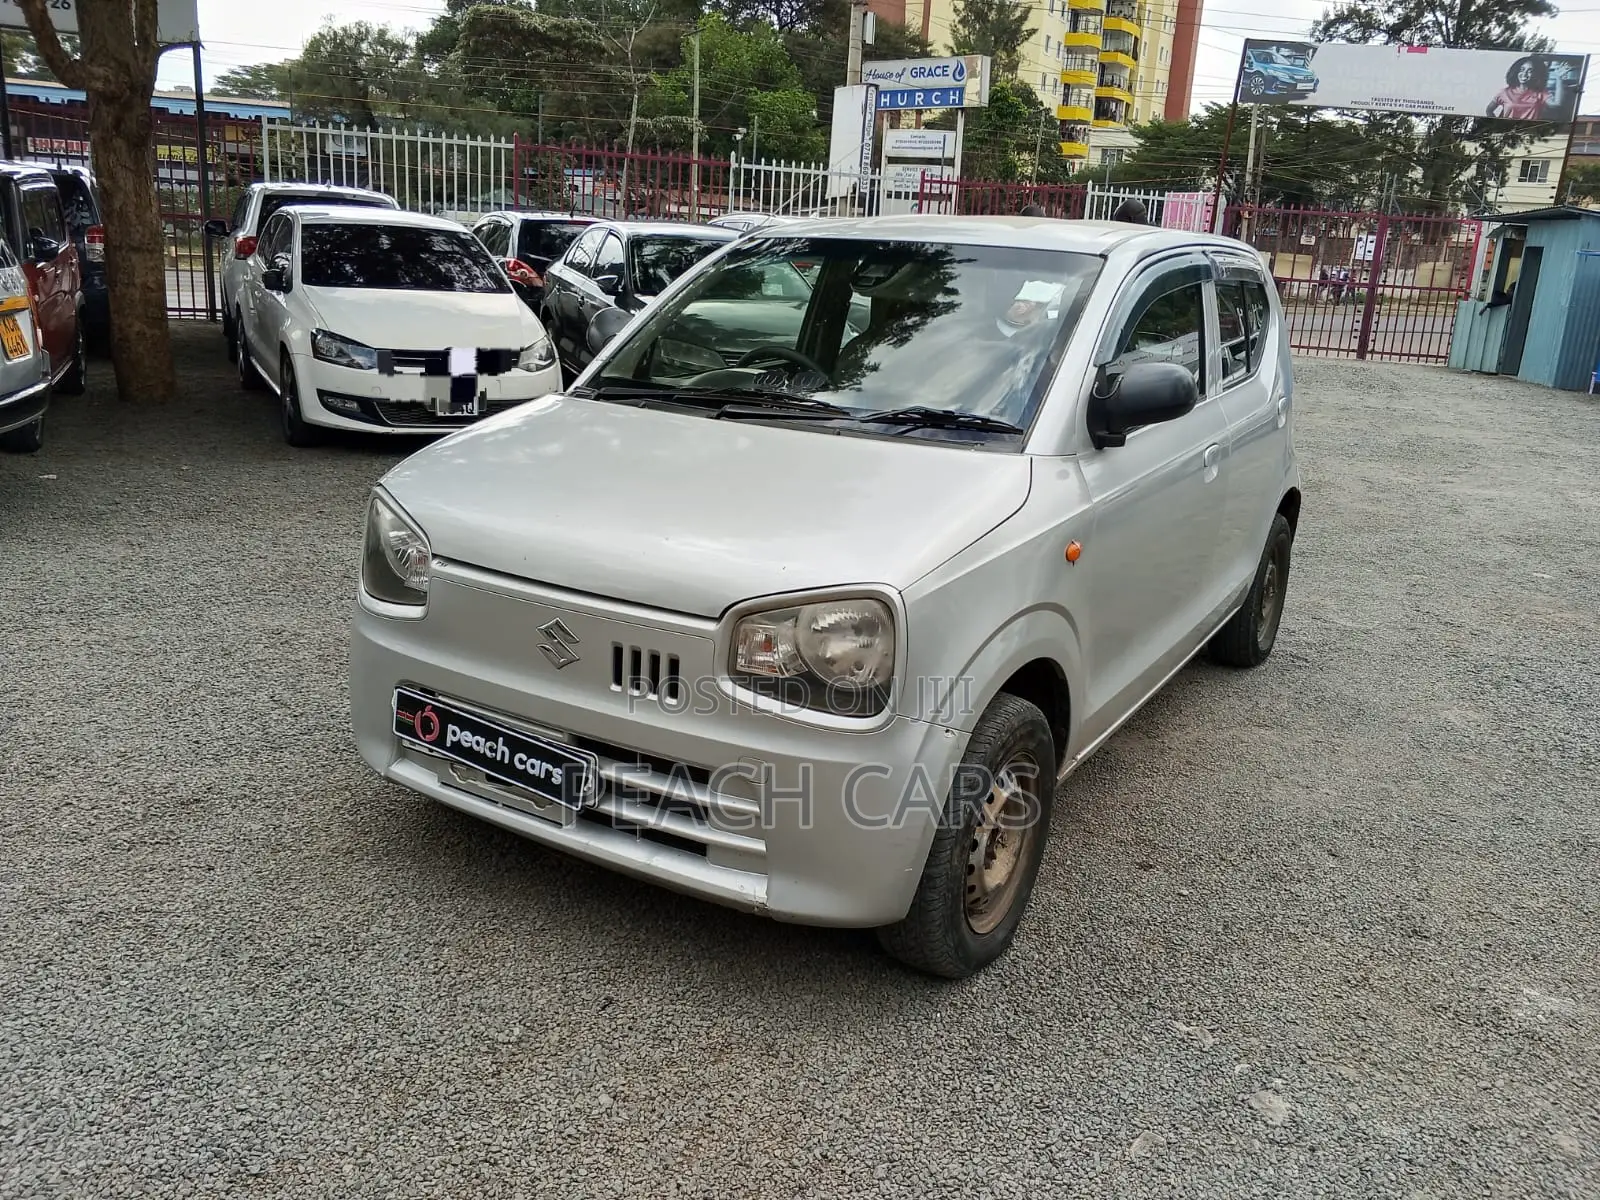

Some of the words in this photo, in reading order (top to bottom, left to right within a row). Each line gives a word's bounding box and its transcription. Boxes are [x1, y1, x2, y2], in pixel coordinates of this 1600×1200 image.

[864, 68, 894, 81] House
[895, 67, 906, 83] of
[910, 65, 950, 79] GRACE
[880, 90, 960, 107] HURCH
[446, 723, 510, 764] peach
[513, 752, 563, 785] cars
